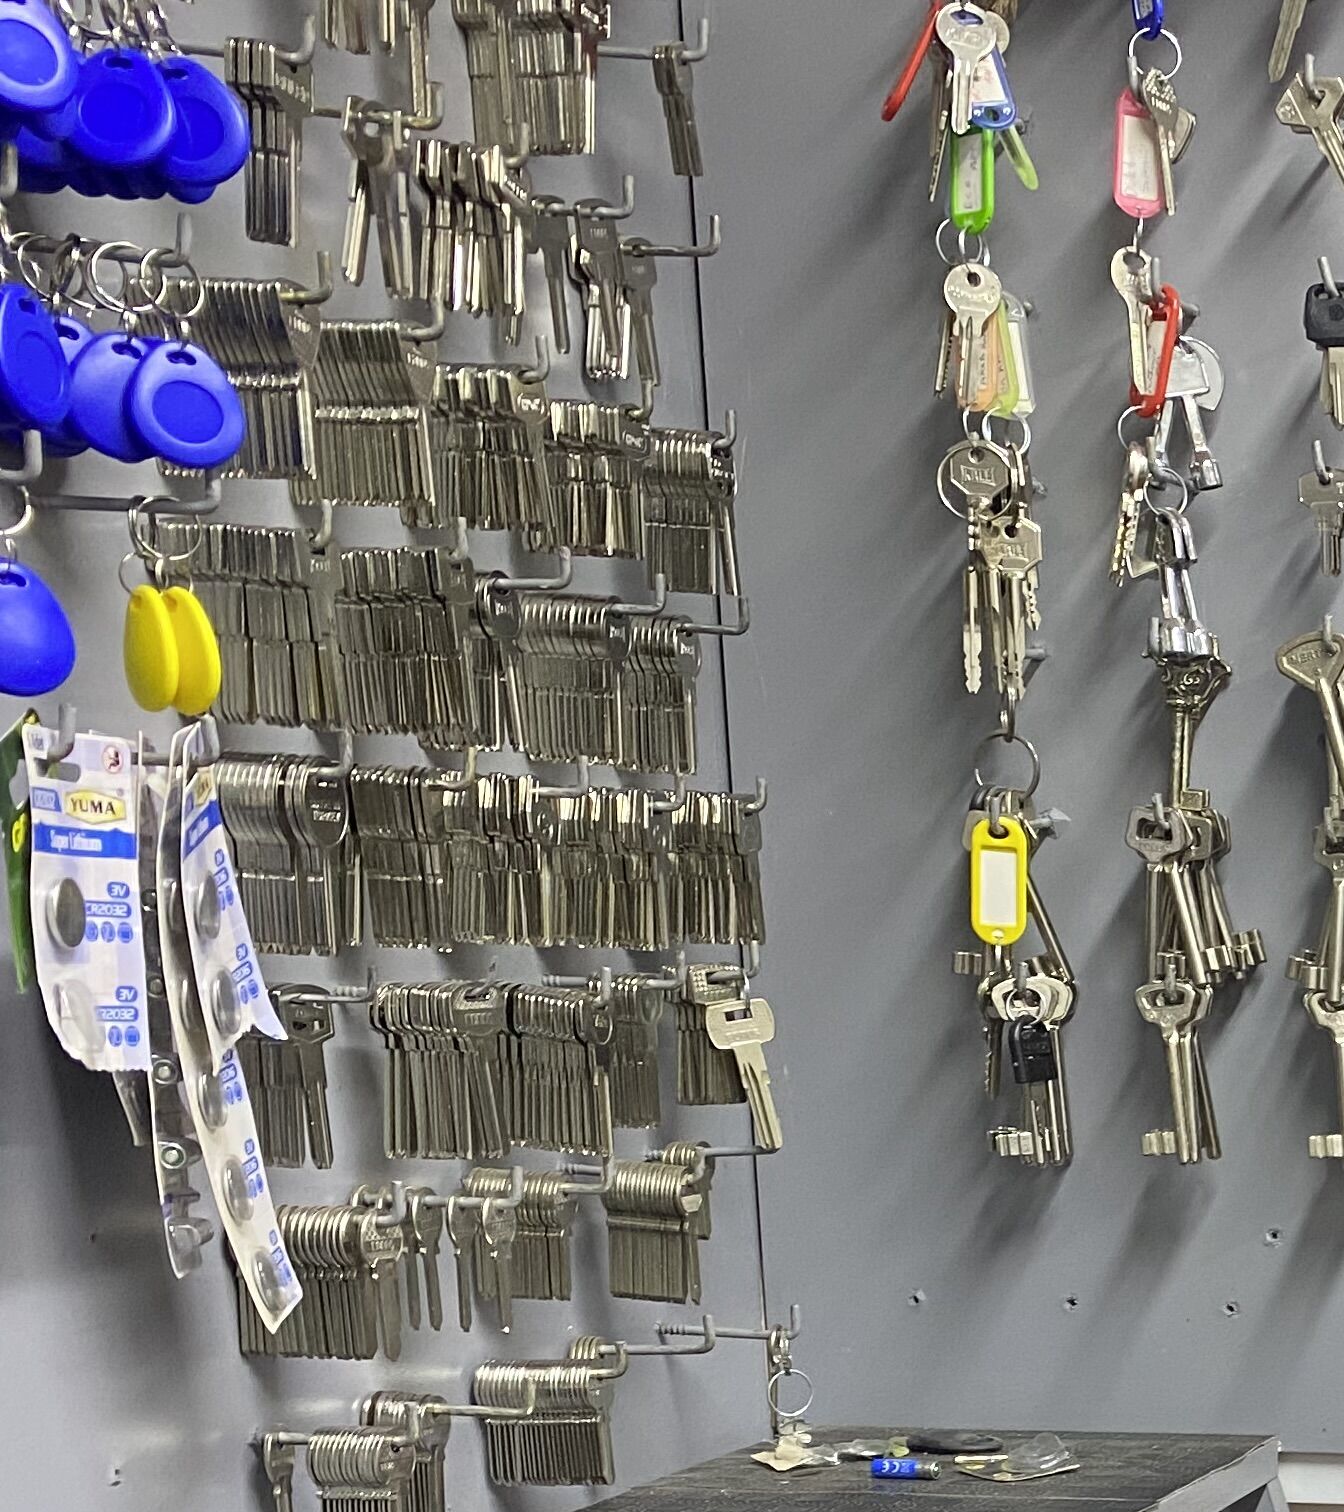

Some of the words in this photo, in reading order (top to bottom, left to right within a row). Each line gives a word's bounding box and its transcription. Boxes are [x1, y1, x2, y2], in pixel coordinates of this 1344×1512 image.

[70, 798, 116, 816] YUMA
[110, 884, 127, 897] 3V
[119, 988, 136, 1001] 3V
